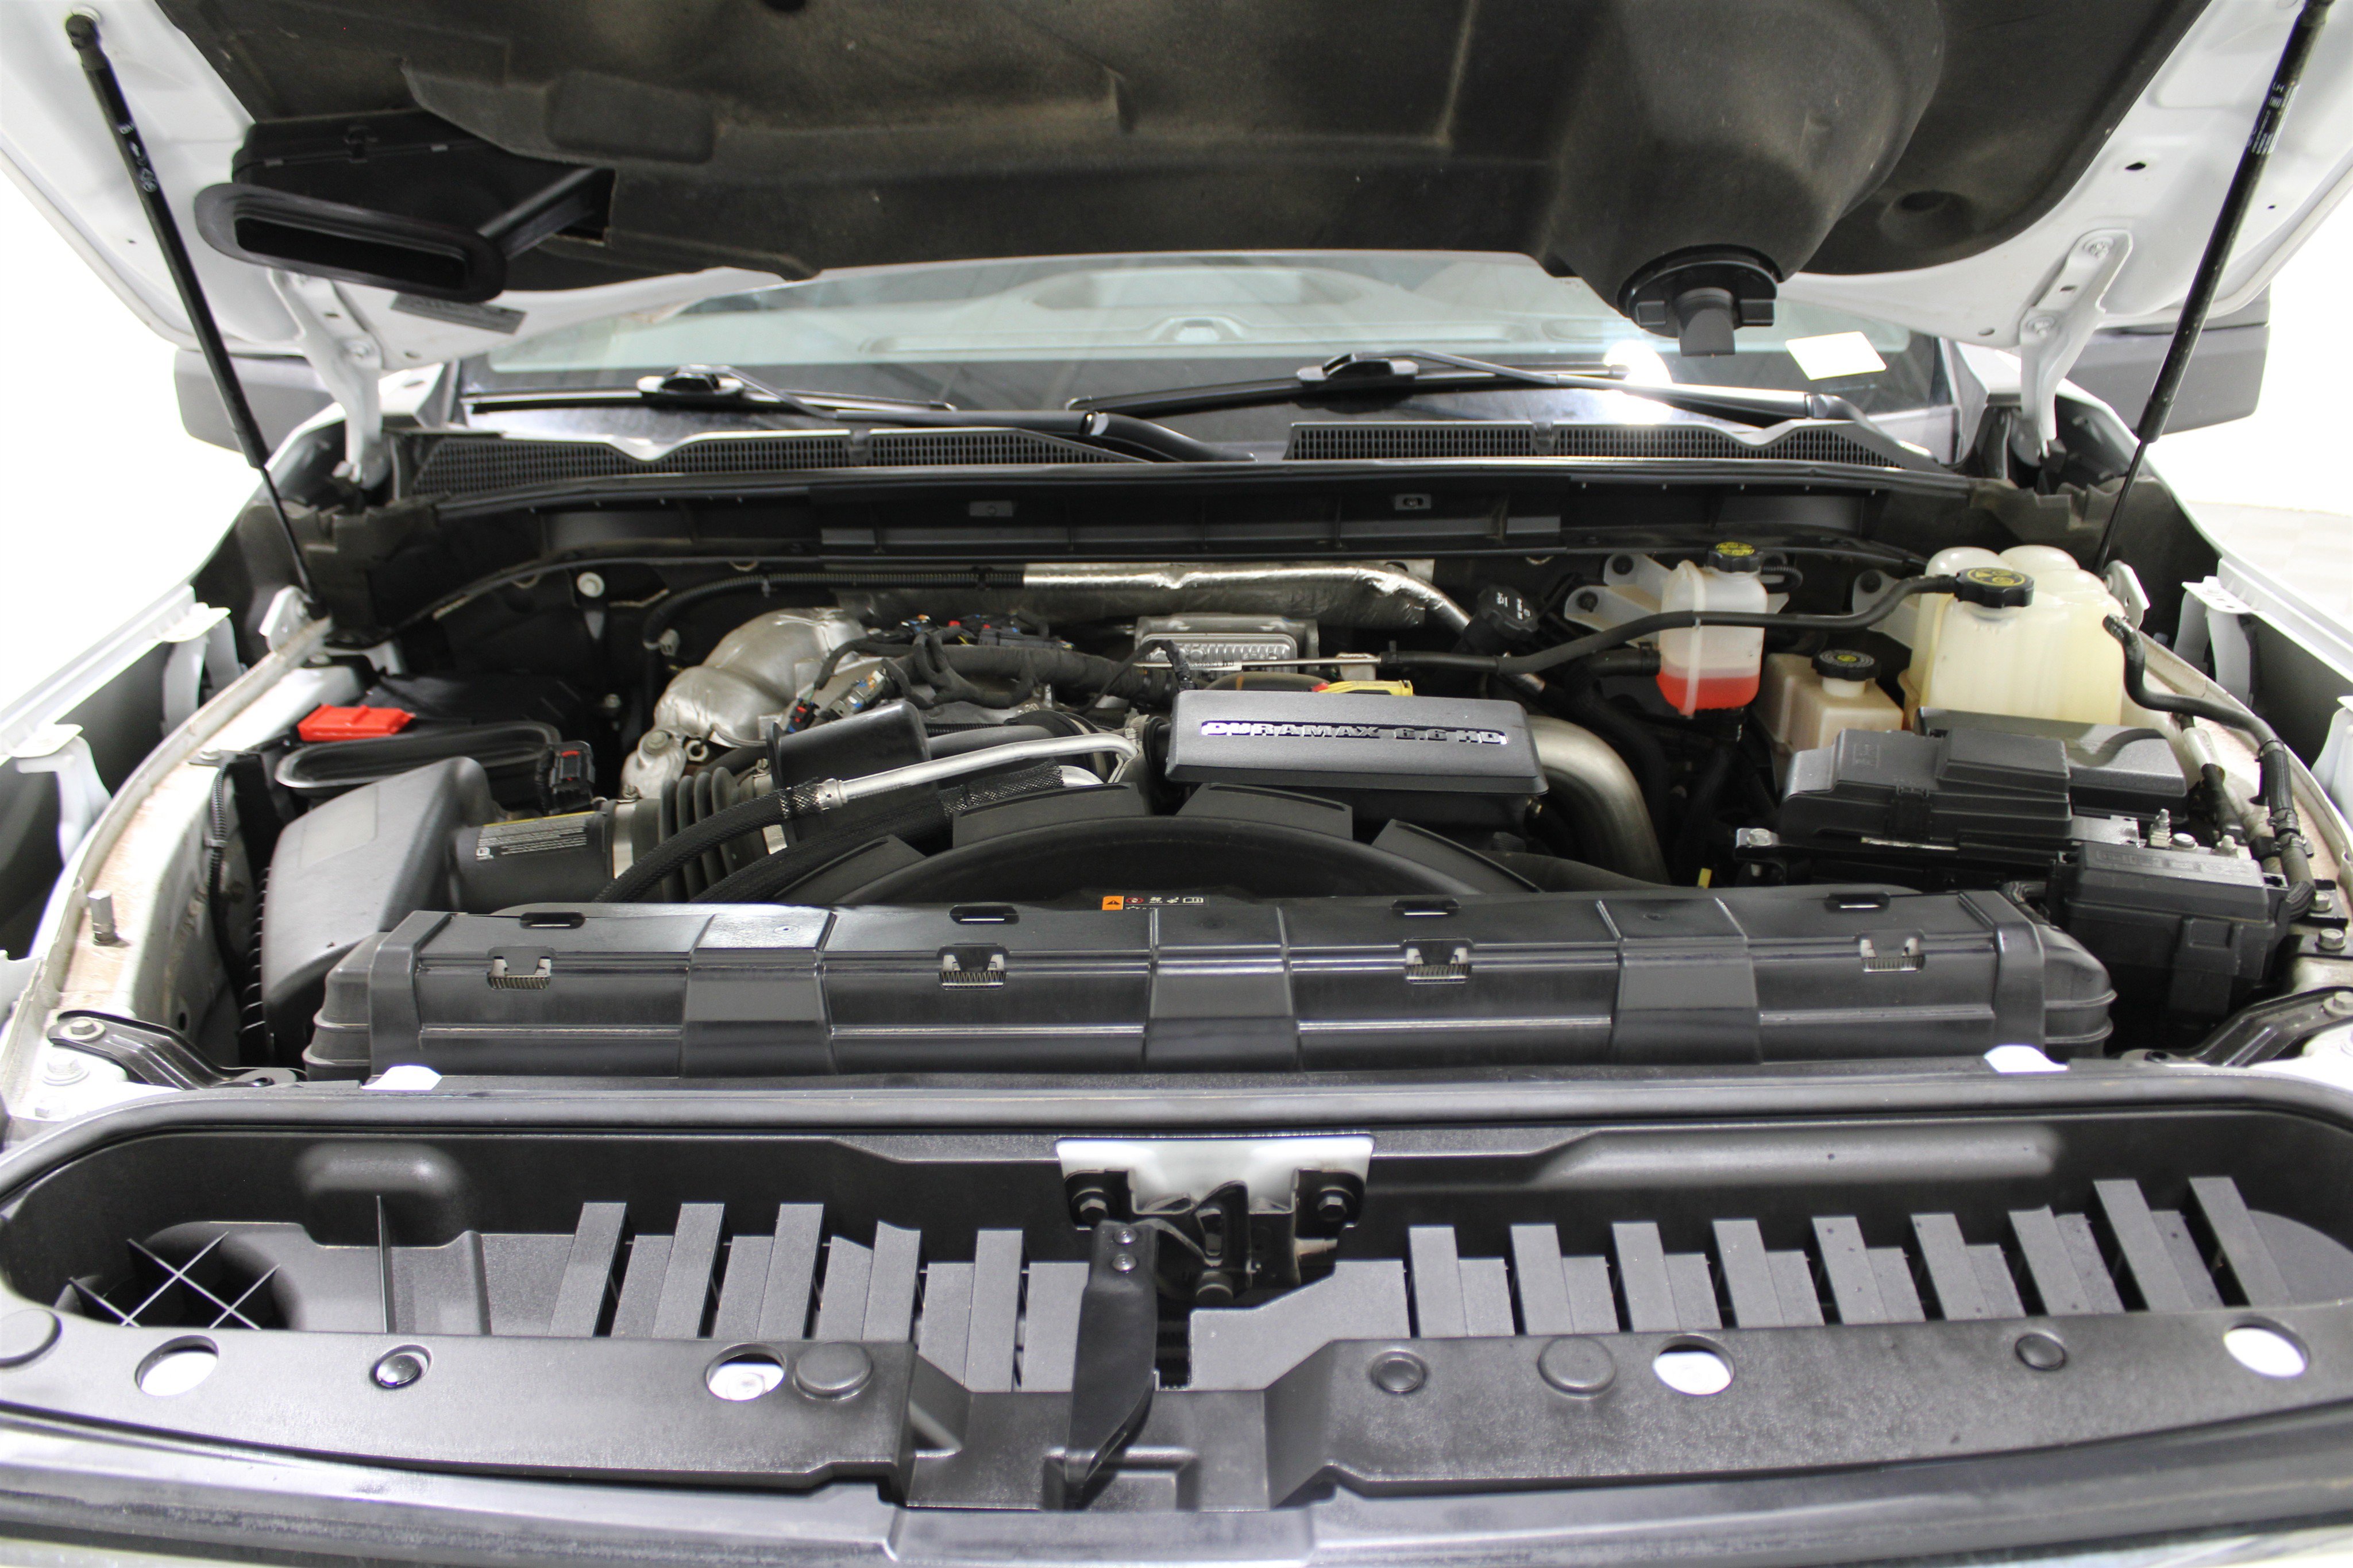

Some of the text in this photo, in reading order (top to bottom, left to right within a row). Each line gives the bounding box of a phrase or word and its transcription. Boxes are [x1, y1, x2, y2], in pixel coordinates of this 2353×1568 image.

[1202, 722, 1506, 745] DURAMAX 6.6 HD
